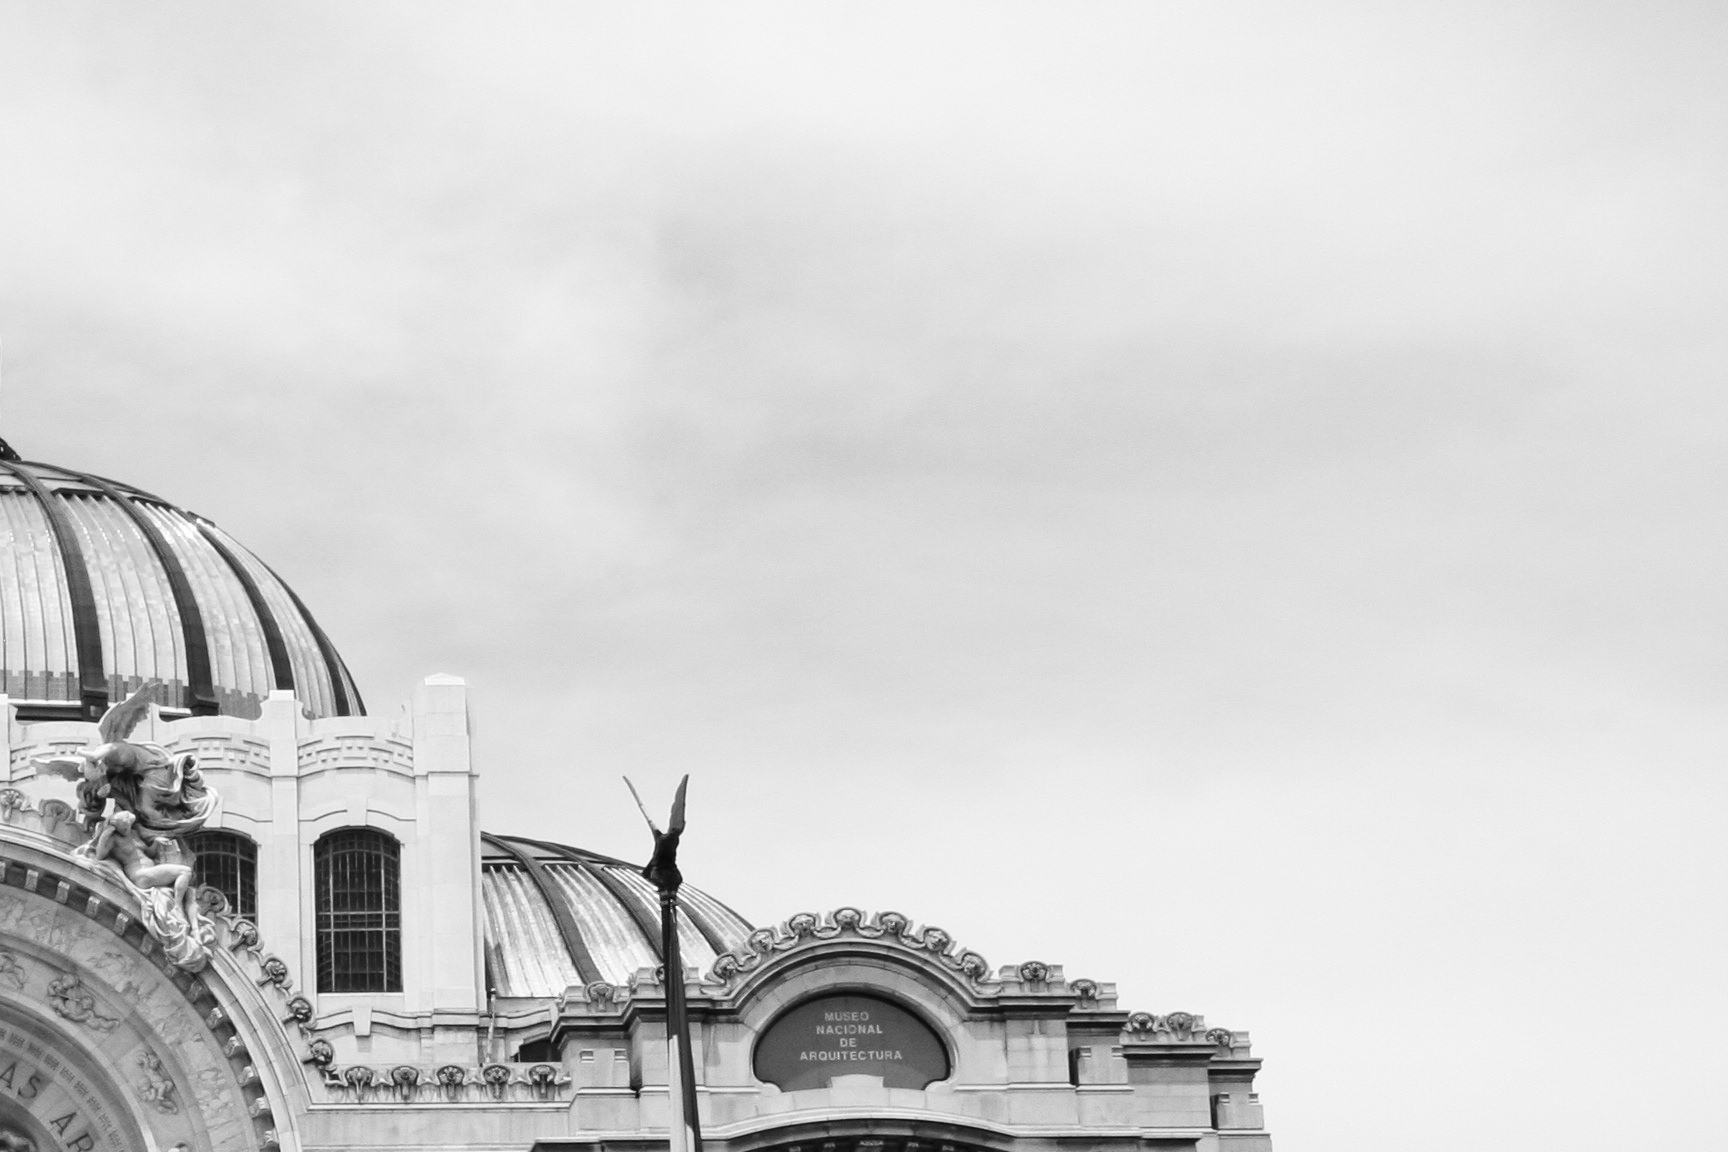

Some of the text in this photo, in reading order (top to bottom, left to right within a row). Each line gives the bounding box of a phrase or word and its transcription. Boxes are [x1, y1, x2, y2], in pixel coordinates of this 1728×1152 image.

[824, 1011, 870, 1022] MUSEO
[815, 1024, 884, 1035] NACIONAL
[839, 1038, 857, 1048] DE
[799, 1050, 903, 1061] ARQUITECTURA
